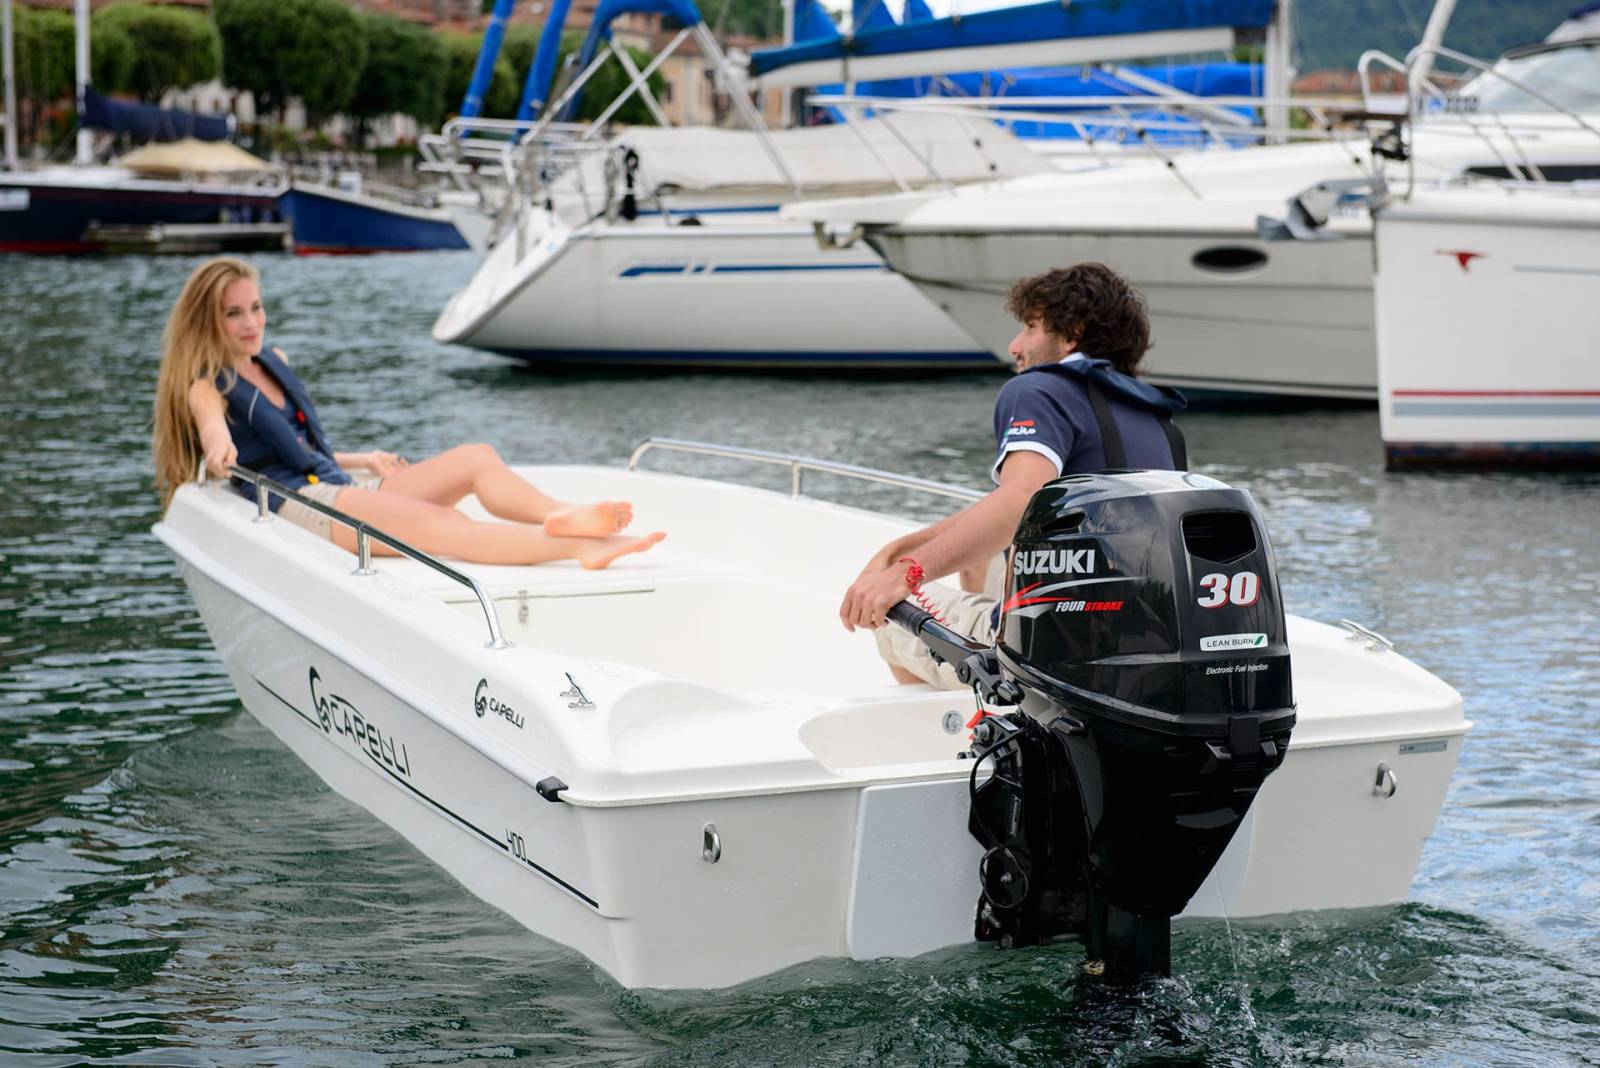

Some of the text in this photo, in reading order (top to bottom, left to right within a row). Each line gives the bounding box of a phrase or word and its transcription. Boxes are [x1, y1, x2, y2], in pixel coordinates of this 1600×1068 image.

[1014, 549, 1095, 575] SUZUKI
[1198, 571, 1261, 609] 30
[1206, 638, 1254, 648] LEAN BURN
[1206, 663, 1269, 675] Electronic Fuel Injection
[489, 697, 525, 729] CAPELLI
[330, 700, 411, 777] CAPELLI
[505, 828, 527, 862] 400
